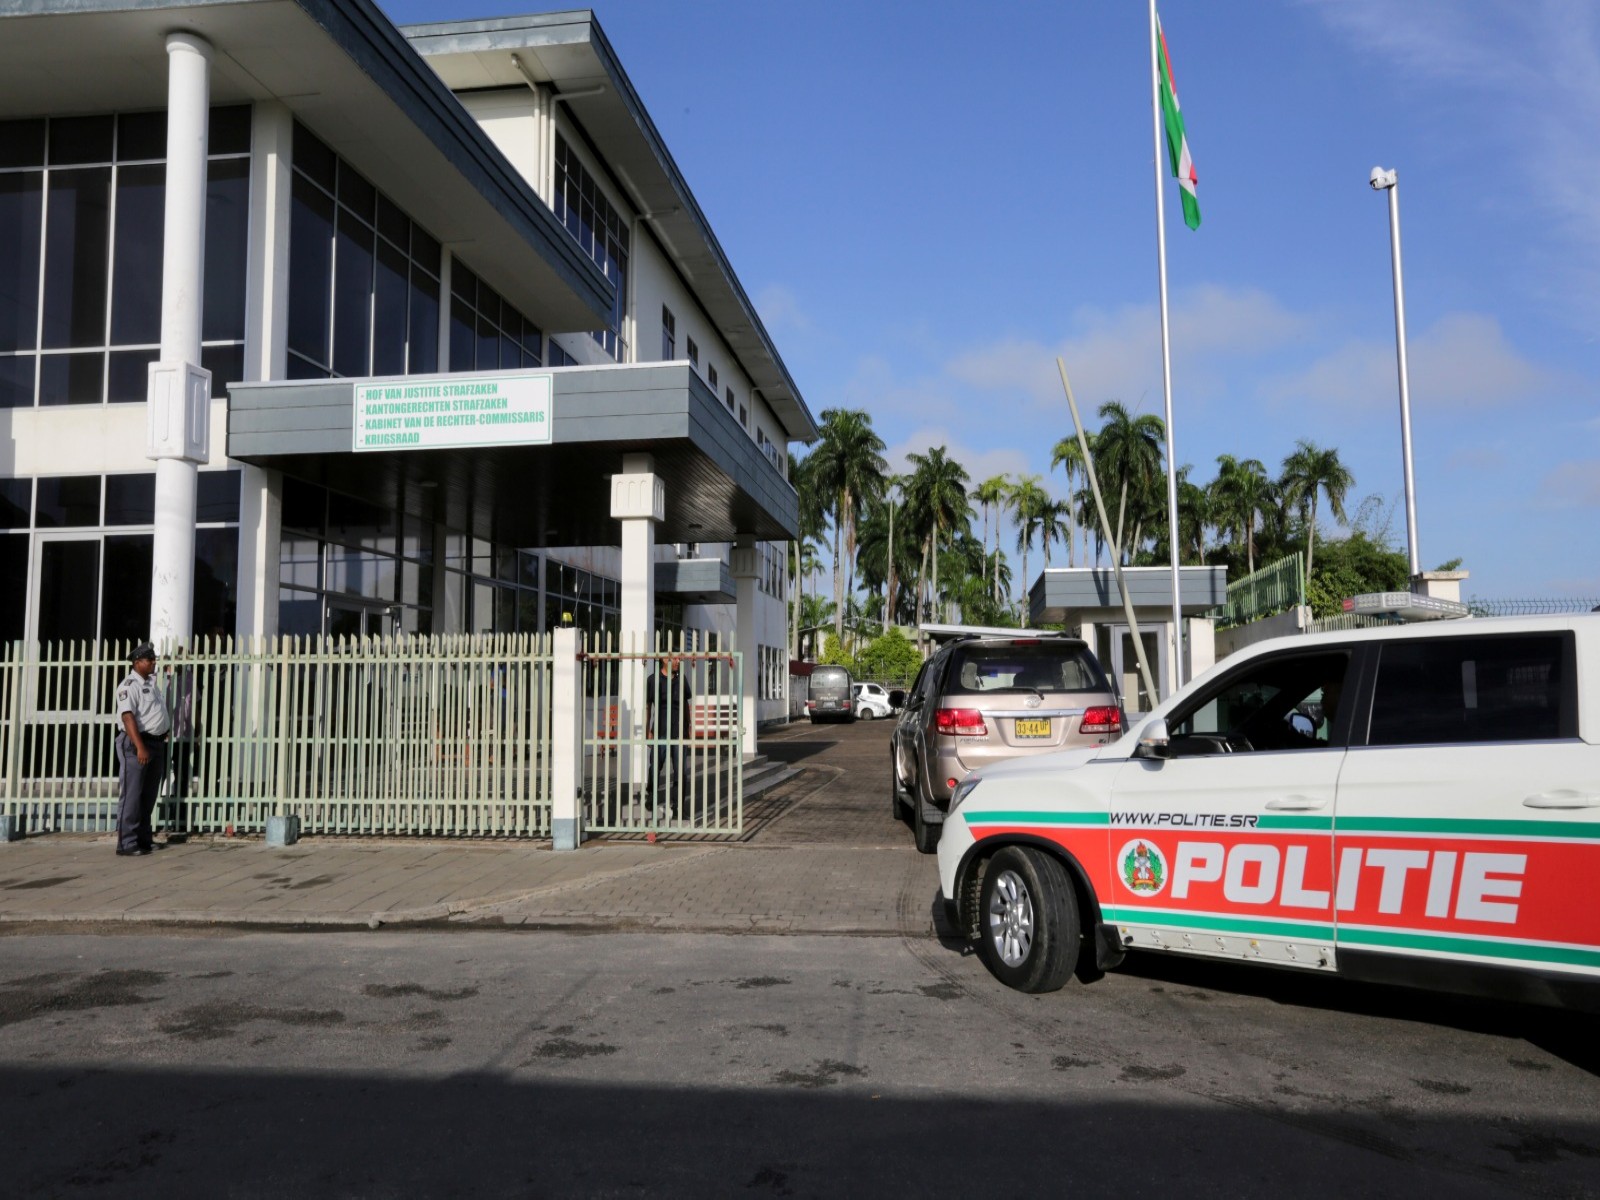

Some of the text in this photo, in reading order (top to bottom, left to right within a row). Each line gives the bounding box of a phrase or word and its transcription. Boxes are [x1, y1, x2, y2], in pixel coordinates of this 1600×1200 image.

[366, 389, 383, 400] HOF
[385, 388, 402, 400] VAN
[404, 386, 441, 399] JUSTITIE
[443, 383, 498, 397] STRAFZAKEN
[366, 400, 451, 415] KANTONGERECHTEN
[452, 398, 508, 411] STRAFZAKEN
[365, 418, 402, 430] KABINET
[404, 417, 422, 428] VAN
[423, 416, 435, 428] DE
[436, 411, 545, 427] RECHTER-COMMISSARIS
[365, 432, 420, 445] KRIJGSRAAD
[1110, 812, 1258, 828] WWW.POLITIE.SR
[1170, 841, 1528, 924] POLITIE
